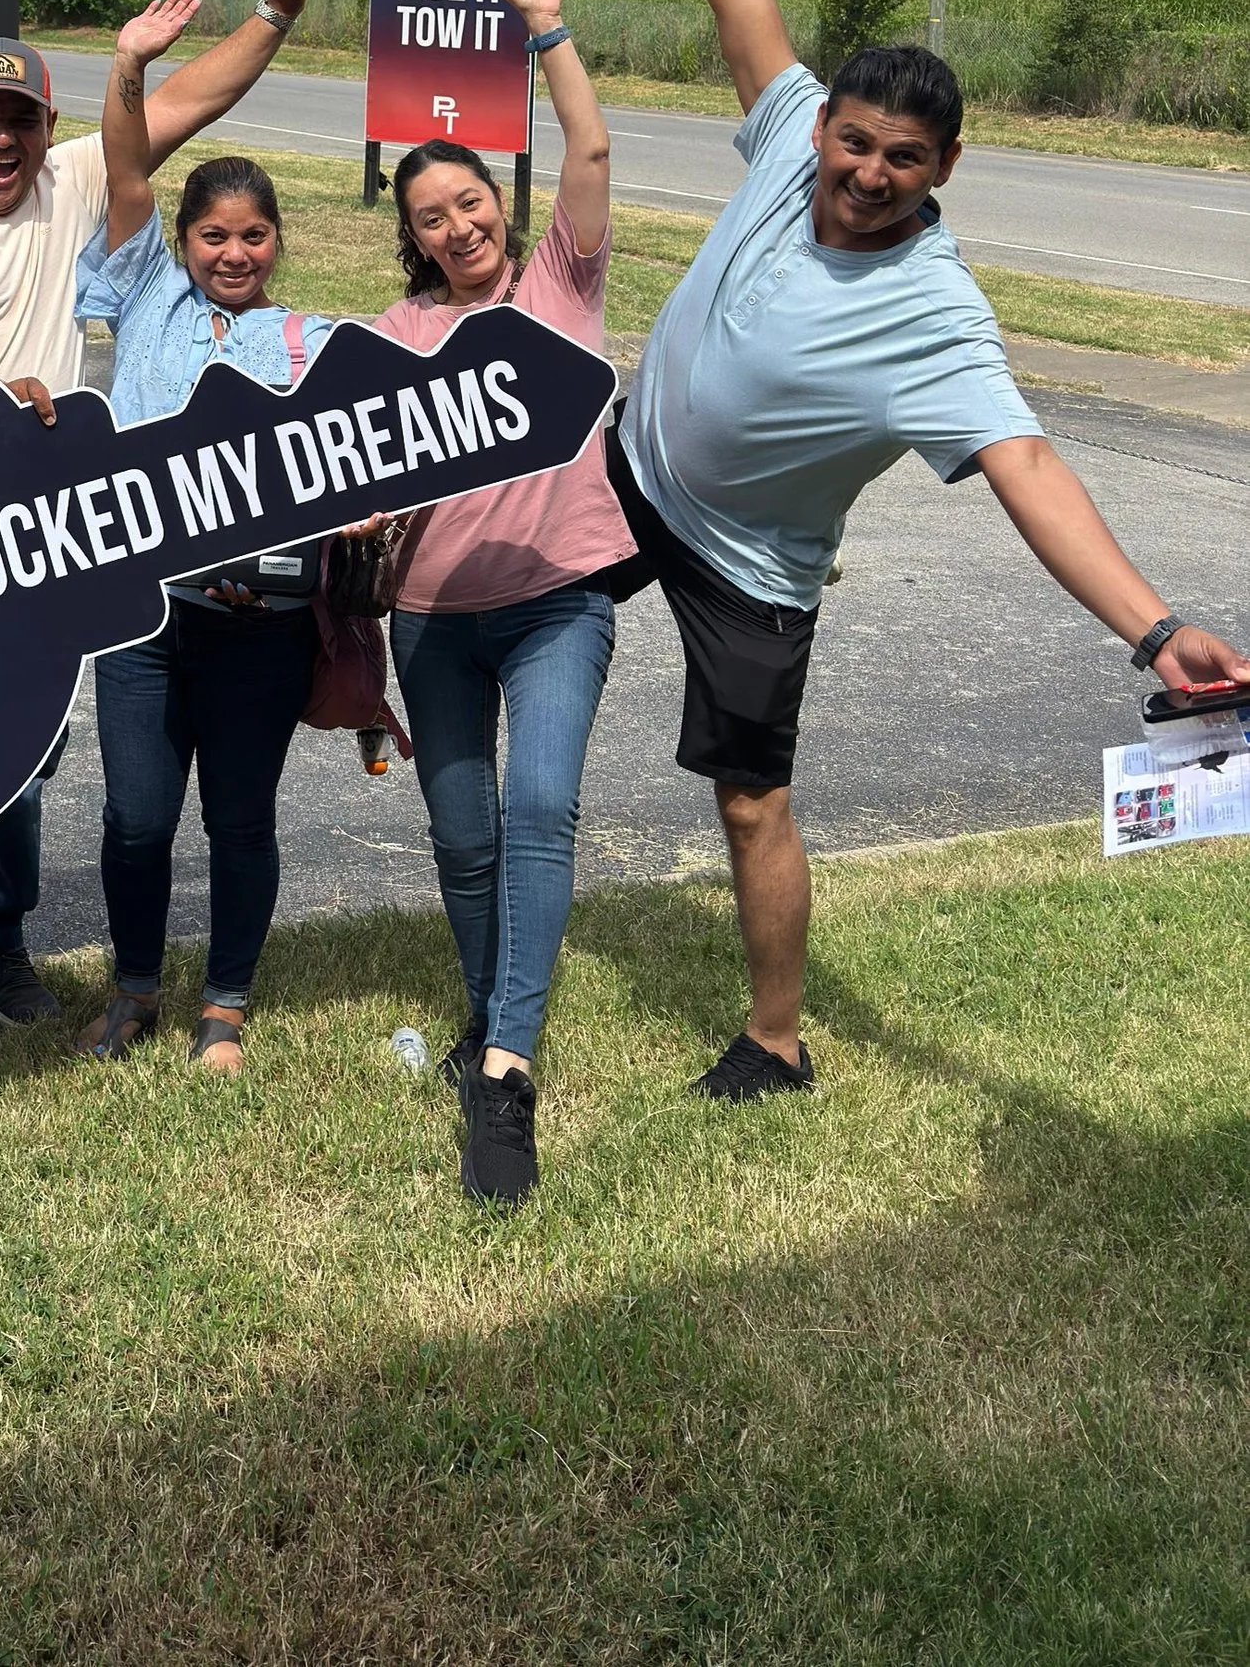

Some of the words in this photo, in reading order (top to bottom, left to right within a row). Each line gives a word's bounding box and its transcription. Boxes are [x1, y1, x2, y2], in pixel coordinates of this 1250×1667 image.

[396, 6, 467, 49] TOW
[474, 10, 505, 52] IT
[432, 95, 460, 135] PT
[166, 432, 264, 538] MY
[273, 360, 531, 505] DREAMS
